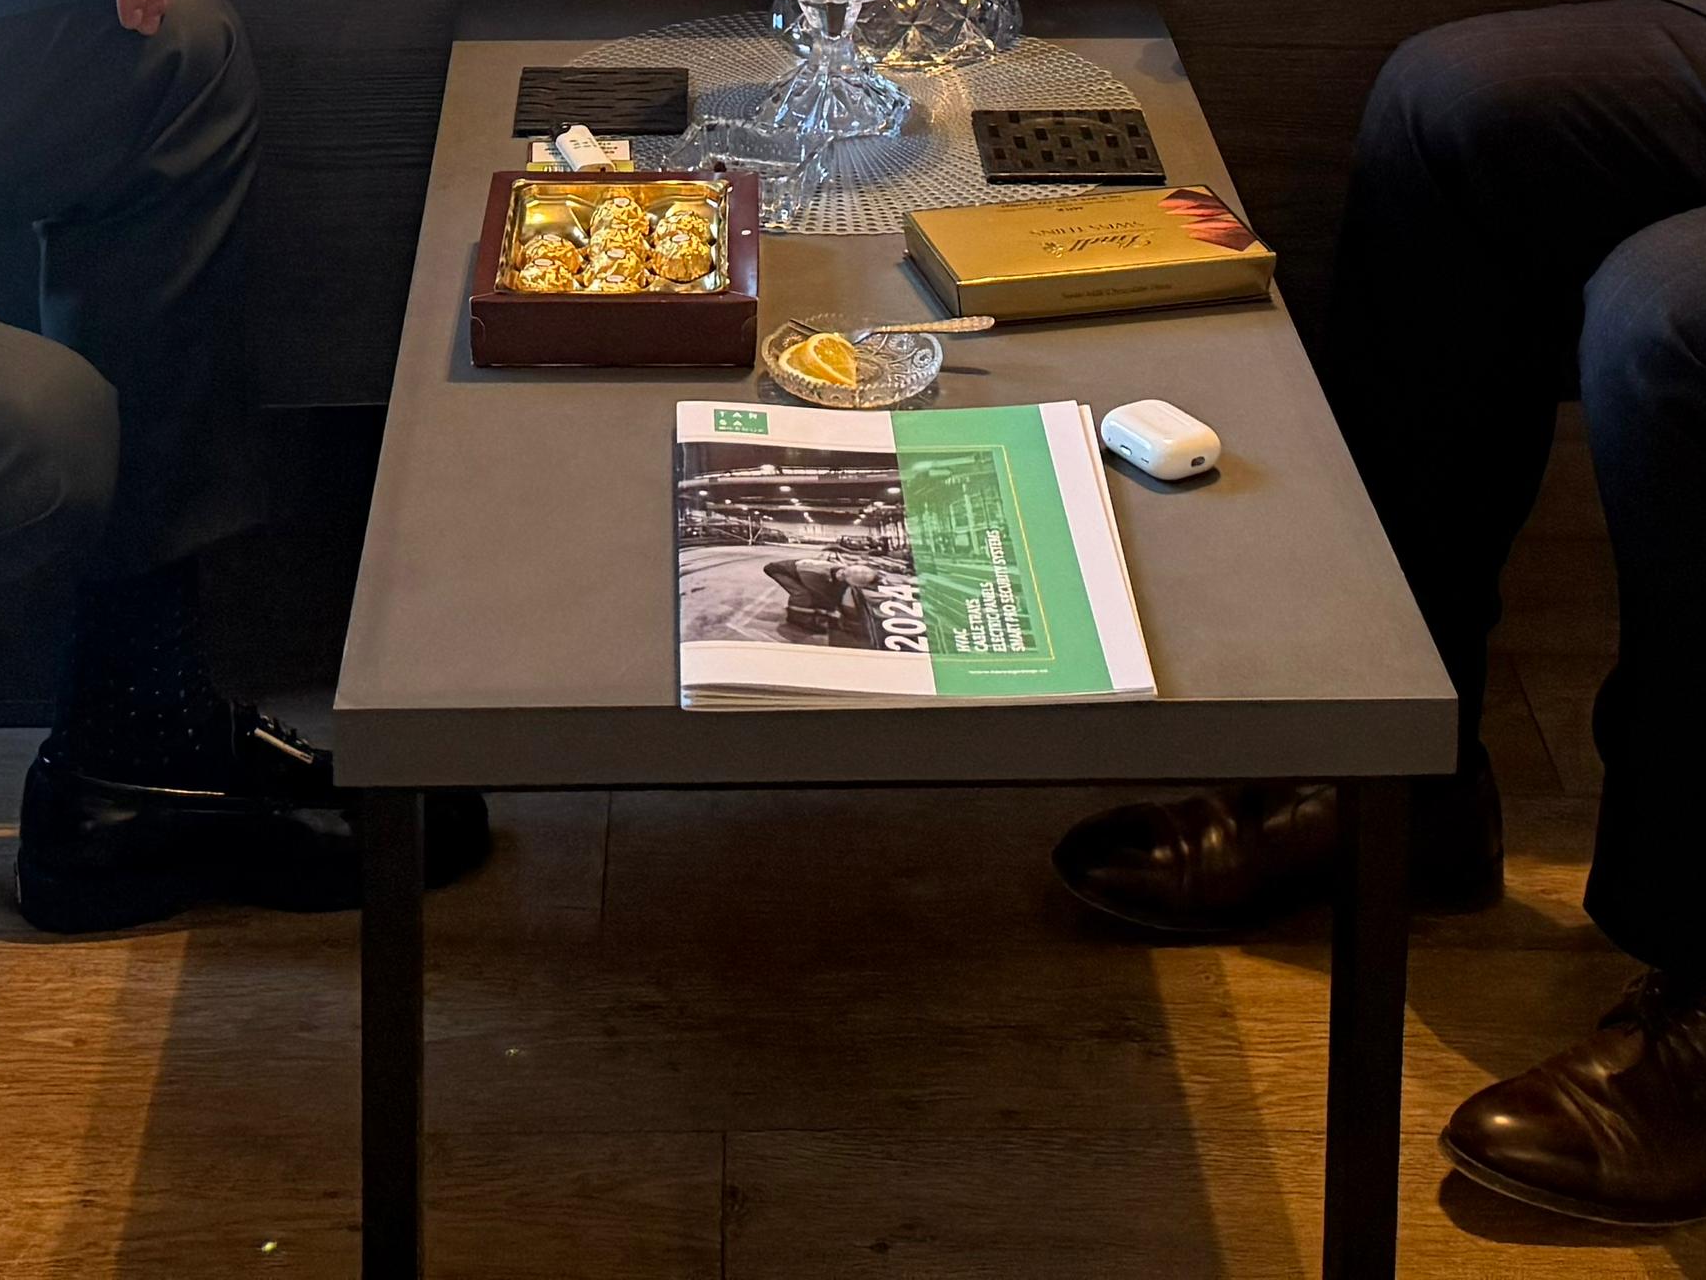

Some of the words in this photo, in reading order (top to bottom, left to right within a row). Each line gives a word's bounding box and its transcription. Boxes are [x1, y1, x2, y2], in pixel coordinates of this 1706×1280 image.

[987, 530, 1006, 565] SYSTEMS
[981, 583, 998, 613] PANELS
[994, 566, 1014, 603] SECURITY
[878, 585, 929, 651] 2024
[966, 599, 981, 625] TRAYS
[1003, 604, 1019, 623] PRO
[954, 628, 971, 652] HVAC
[972, 626, 988, 652] CABLE
[987, 614, 1006, 652] ELECTRIC
[1006, 622, 1025, 652] SMART
